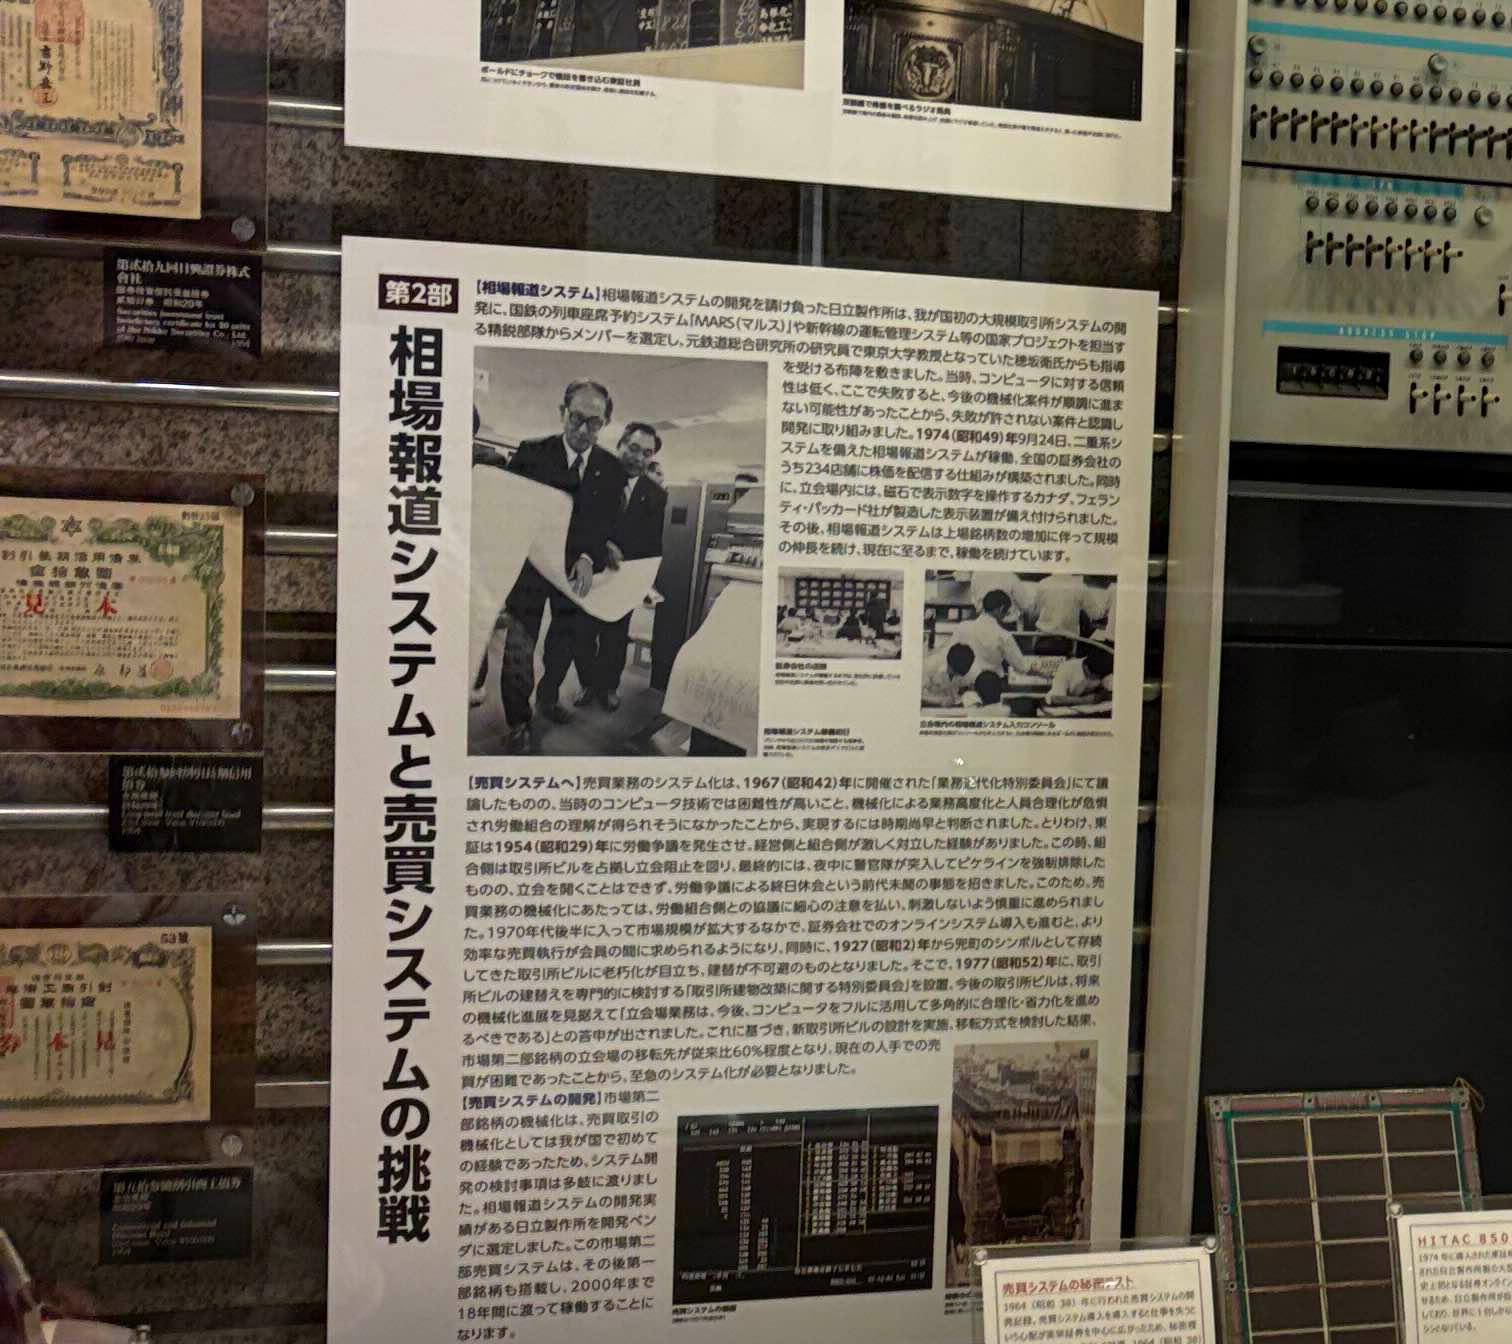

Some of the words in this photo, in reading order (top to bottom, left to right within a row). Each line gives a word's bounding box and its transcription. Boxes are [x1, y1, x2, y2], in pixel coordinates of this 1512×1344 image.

[384, 280, 454, 308] 第2部
[377, 325, 444, 1245] 相場報道システムと売買システムの挑戦
